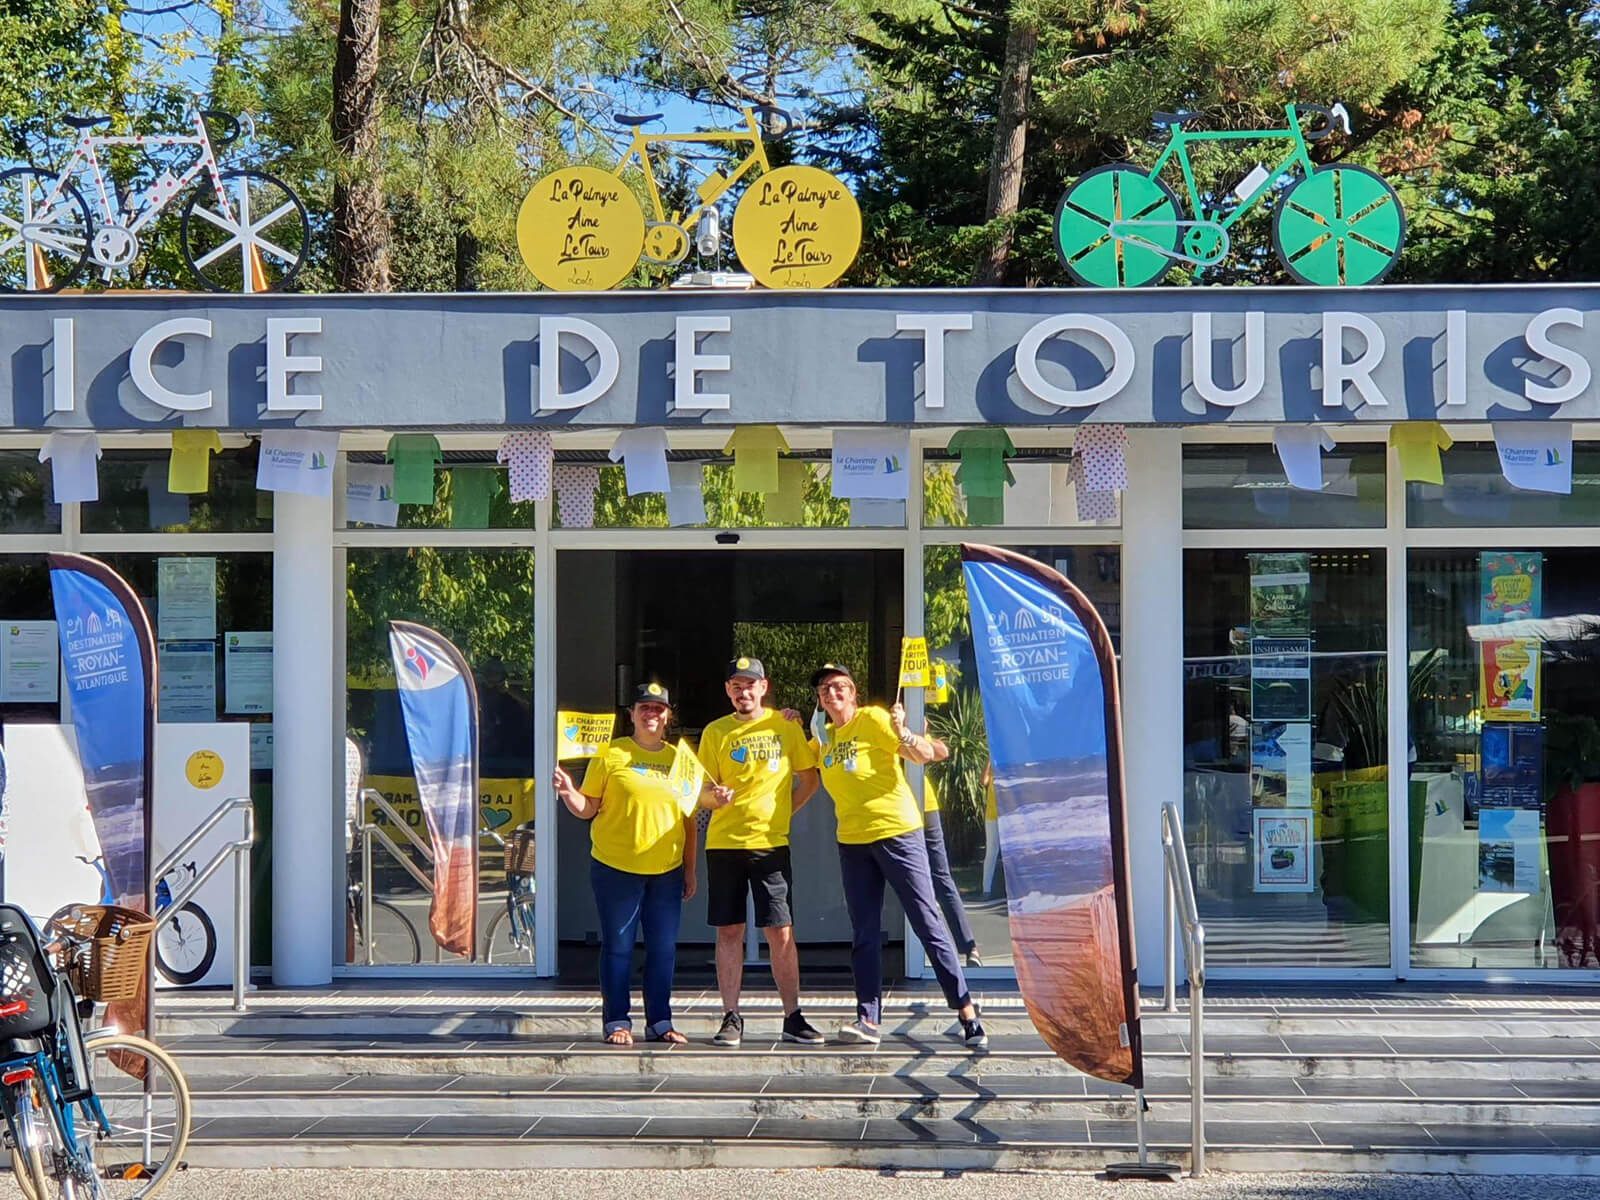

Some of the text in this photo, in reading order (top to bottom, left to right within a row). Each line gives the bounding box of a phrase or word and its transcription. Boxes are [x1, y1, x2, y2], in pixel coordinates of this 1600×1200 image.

[550, 178, 619, 207] La Palmyre
[759, 180, 841, 209] La Palmyre
[567, 206, 600, 230] Aime
[781, 209, 820, 233] Aime
[560, 233, 610, 258] Le Tour
[772, 238, 832, 264] Le Tour
[53, 307, 1592, 412] ICE DE TOURIS
[67, 631, 123, 652] DESTINATION
[987, 628, 1067, 649] DESTINATION
[75, 671, 129, 692] ATLANTIQUE
[994, 667, 1071, 688] ATLANTIQUE
[580, 732, 610, 744] TOUR
[752, 749, 783, 761] TOUR
